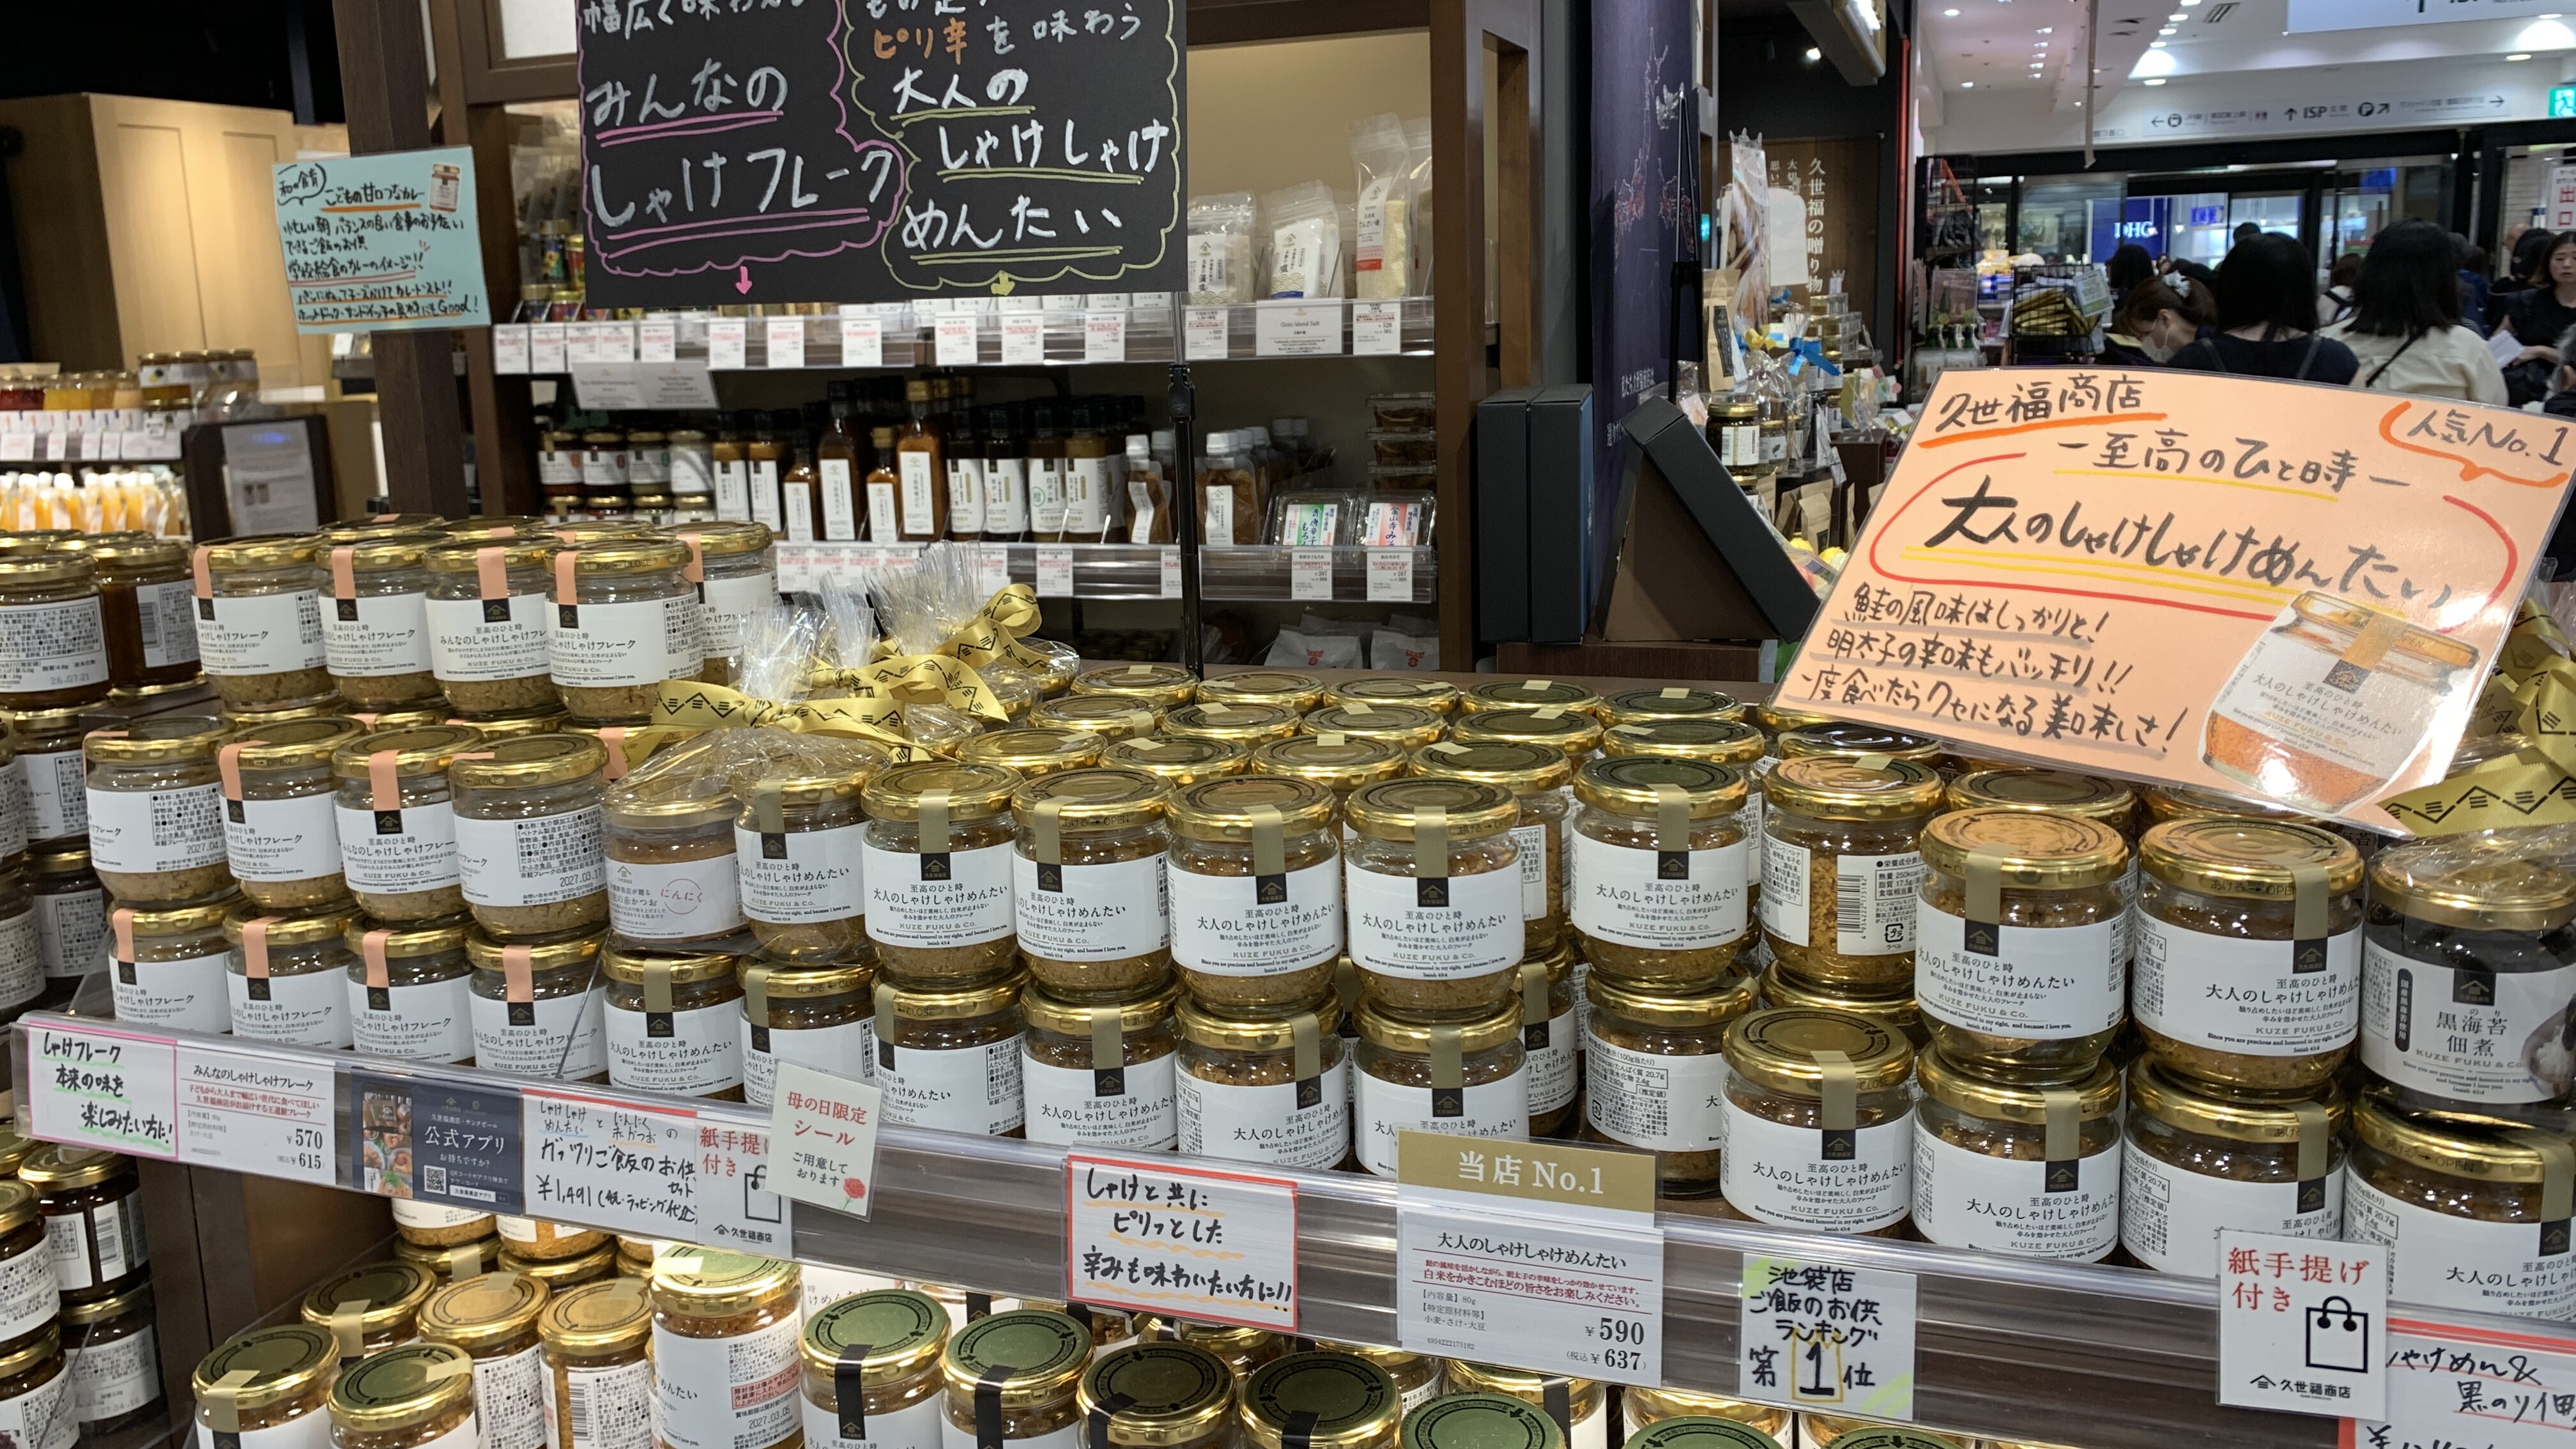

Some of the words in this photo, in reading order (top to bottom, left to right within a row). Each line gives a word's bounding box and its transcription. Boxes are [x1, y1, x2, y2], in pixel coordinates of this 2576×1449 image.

[586, 58, 788, 126] みんなの
[894, 68, 1030, 113] 大人の
[2303, 107, 2326, 118] ISP
[939, 119, 1169, 172] しゃけしゃけ
[591, 149, 893, 226] しゃけフレーク
[903, 195, 1123, 250] めんたい
[1806, 158, 1825, 293] 久世福の贈り物
[1936, 374, 2145, 433] 久世福商店
[1925, 474, 2452, 611] 大人のしゃけしゃけめんたい
[1103, 815, 1130, 826] OPEN
[560, 868, 602, 887] 2027.03.17
[910, 883, 963, 893] 至高のひと時
[1644, 883, 1700, 893] 至高のひと時
[874, 885, 1008, 905] 大人のしゃけしゃけめんたい
[1030, 892, 1075, 905] 至高のひと時
[1597, 884, 1738, 905] 大人のしゃけしゃけめんたい
[1197, 903, 1335, 931] 大人のしゃけしゃけめんたい
[1245, 904, 1300, 919] 至高のひと時
[1363, 912, 1506, 933] 大人のしゃけしゃけめんたい
[1406, 910, 1462, 920] 至高のひと時
[1263, 949, 1289, 957] FUKU
[1952, 951, 2014, 973] 至高のひと時
[1919, 946, 2074, 989] 大人のしゃけしゃけめんたい
[2206, 976, 2359, 1004] 大人のしゃけしゃけめんた
[2276, 974, 2336, 989] 至高のひと時
[1939, 992, 1962, 1007] KUZE
[1966, 1002, 1996, 1015] FUKU
[2437, 1011, 2508, 1036] 黒海苔
[43, 1032, 121, 1064] しゃけフレーク
[610, 1041, 733, 1060] 大人のしゃけしゃけめんたい
[638, 1039, 687, 1049] 至高のひと時
[2446, 1035, 2494, 1057] 佃煮
[56, 1064, 125, 1096] 本来の味を
[194, 1064, 313, 1091] みんなのしゃけしゃけフレーク
[787, 1091, 867, 1126] 母の日限定
[1084, 1096, 1137, 1110] 至高のひと時
[1285, 1103, 1331, 1126] 至高のひと時
[81, 1101, 172, 1144] 楽しみたい方に!
[793, 1119, 855, 1146] シール
[424, 1126, 504, 1154] 公式アプリ
[700, 1128, 769, 1155] 紙手提
[703, 1154, 737, 1177] 付き
[792, 1151, 848, 1175] ご用意して
[1753, 1162, 1906, 1187] 大人のしゃけしゃけめんたい
[1807, 1163, 1867, 1173] 至高のひと時
[797, 1169, 840, 1188] おります
[1087, 1167, 1208, 1210] しゃけと共に
[1791, 1205, 1820, 1214] KUZE
[2029, 1193, 2090, 1208] 至高のひと時
[731, 1229, 772, 1243] 久世福商店
[1114, 1210, 1222, 1244] ピリッとした
[1438, 1232, 1627, 1269] 大人のしゃけしゃけめんたい
[2228, 1247, 2370, 1285] 紙手提げ
[1768, 1266, 1855, 1294] 池袋店
[1749, 1289, 1882, 1325] ご飯のお供
[2232, 1285, 2292, 1312] 付き
[1776, 1320, 1878, 1347] ランキング
[2281, 1379, 2351, 1399] 久世福商店
